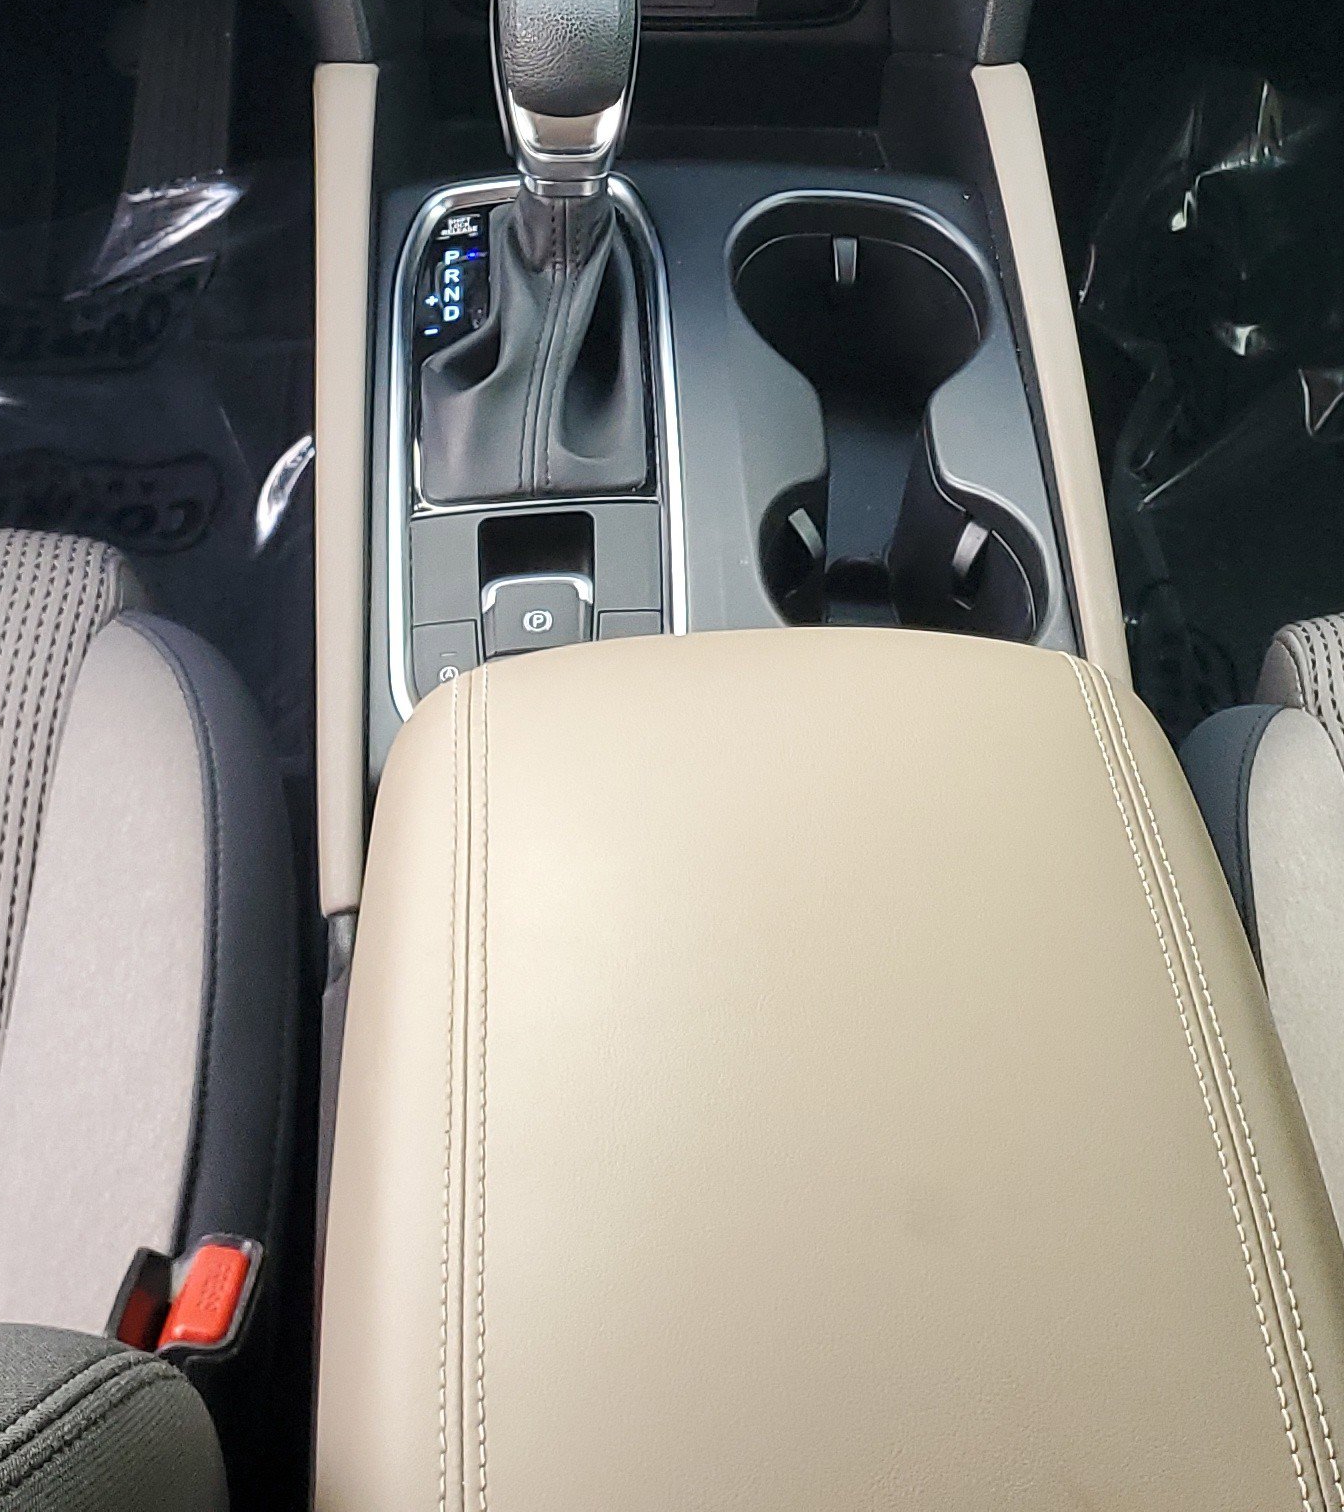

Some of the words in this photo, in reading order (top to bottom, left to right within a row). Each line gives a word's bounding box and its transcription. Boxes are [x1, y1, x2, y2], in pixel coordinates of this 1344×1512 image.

[444, 250, 460, 266] P
[444, 268, 460, 284] R
[443, 286, 460, 303] N
[443, 305, 460, 323] D
